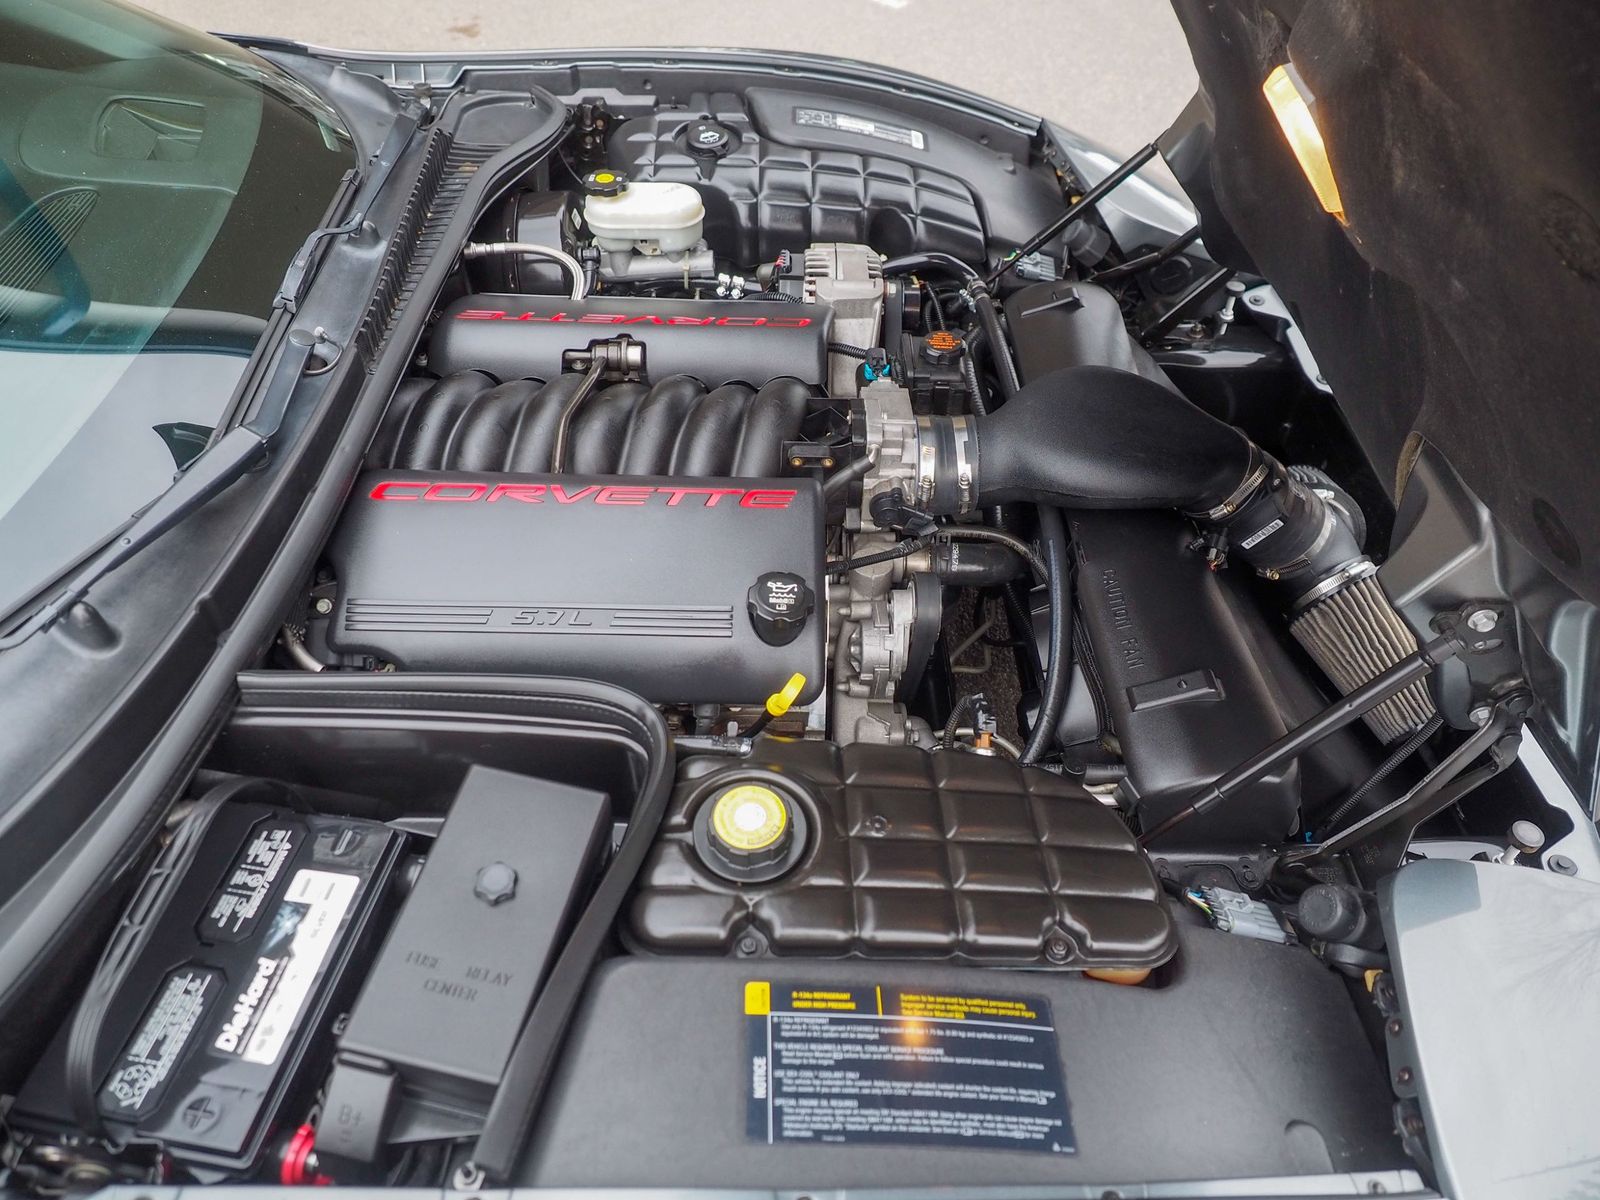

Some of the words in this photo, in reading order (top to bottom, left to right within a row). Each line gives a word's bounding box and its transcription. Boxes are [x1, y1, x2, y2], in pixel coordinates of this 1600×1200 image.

[456, 309, 813, 327] CORVETTE
[368, 481, 798, 509] CORVETTE
[510, 609, 593, 627] 5.7L
[1103, 568, 1132, 630] CAUTION
[1121, 638, 1145, 669] FAN
[214, 956, 278, 1052] DieHard
[753, 1055, 767, 1099] NOTICE
